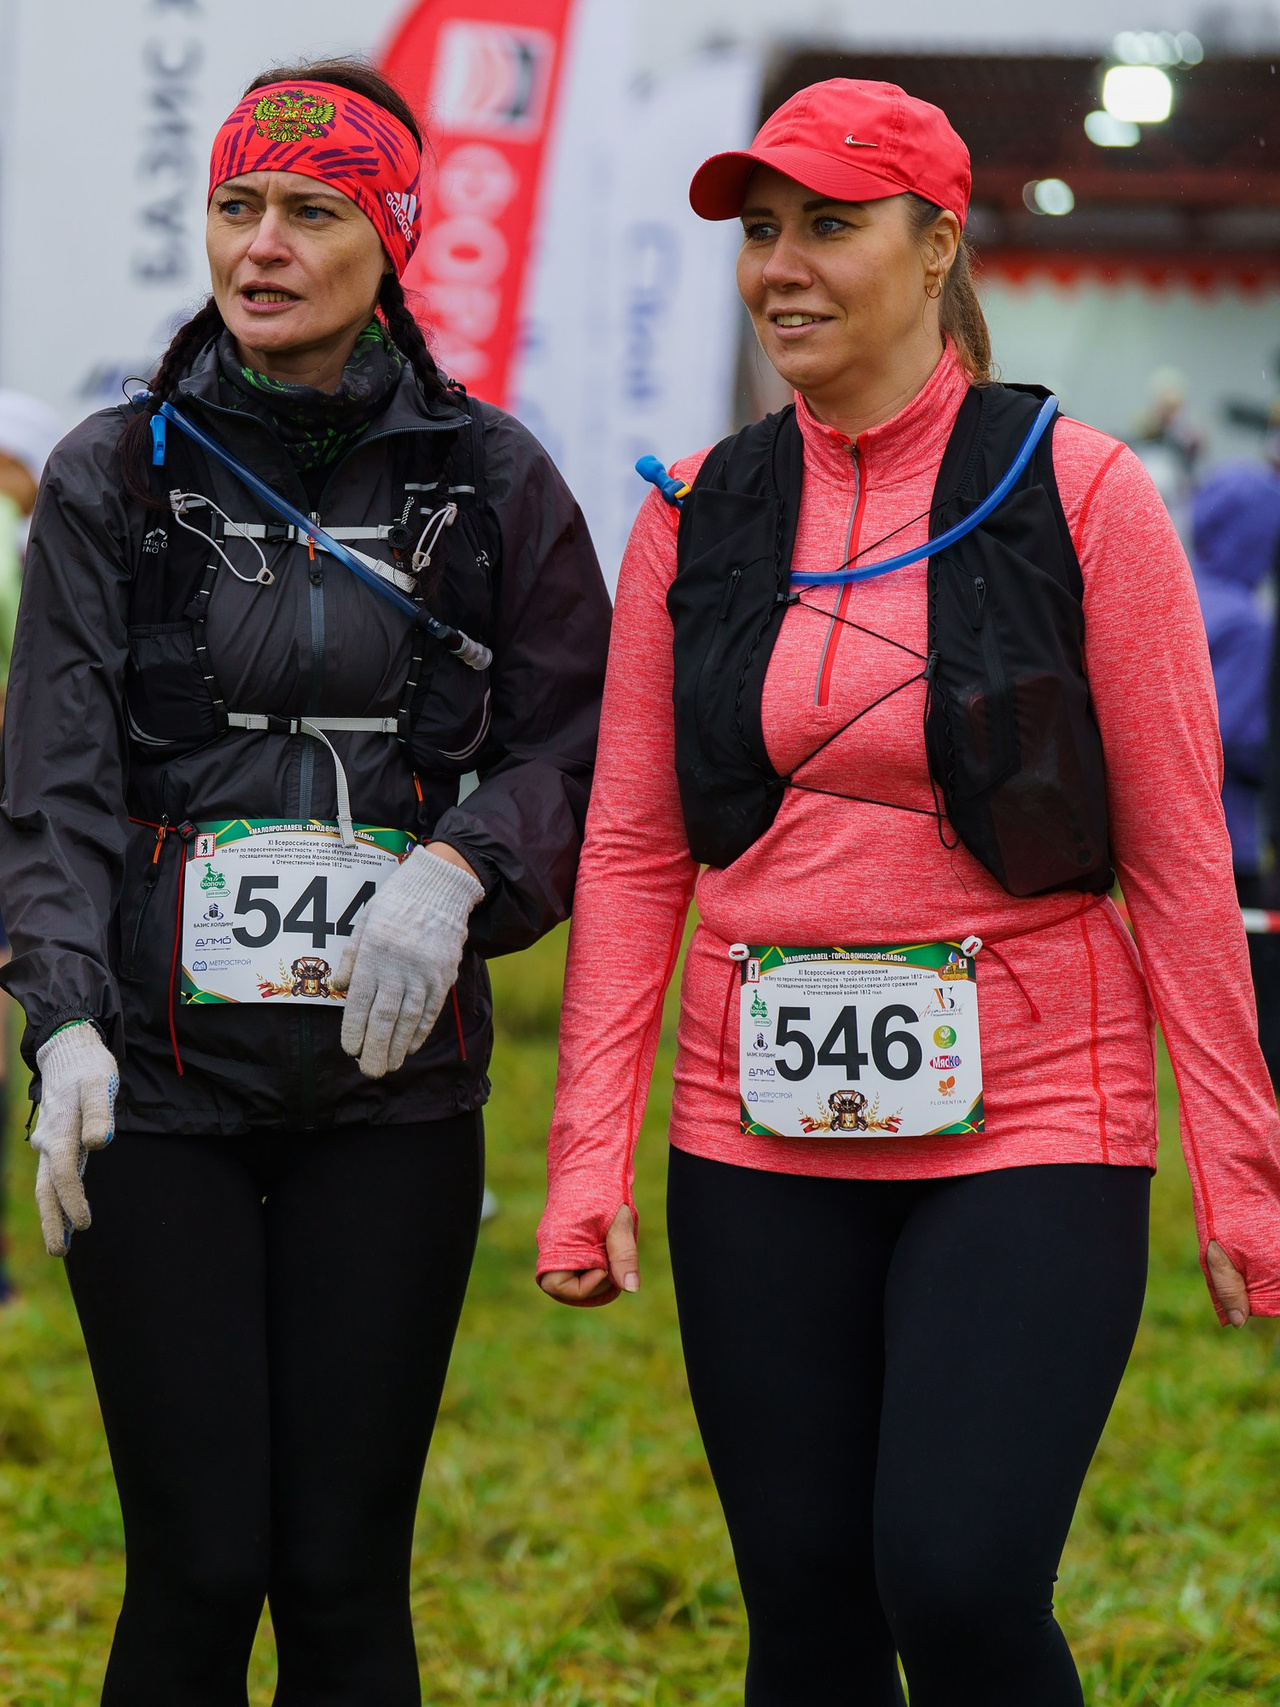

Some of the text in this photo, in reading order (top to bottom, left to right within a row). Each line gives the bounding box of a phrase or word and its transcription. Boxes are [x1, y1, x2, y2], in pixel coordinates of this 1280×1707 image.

[386, 192, 412, 242] adidas
[312, 855, 360, 864] Малоярославецкого
[775, 1004, 922, 1081] 546
[932, 1055, 960, 1068] МясКО
